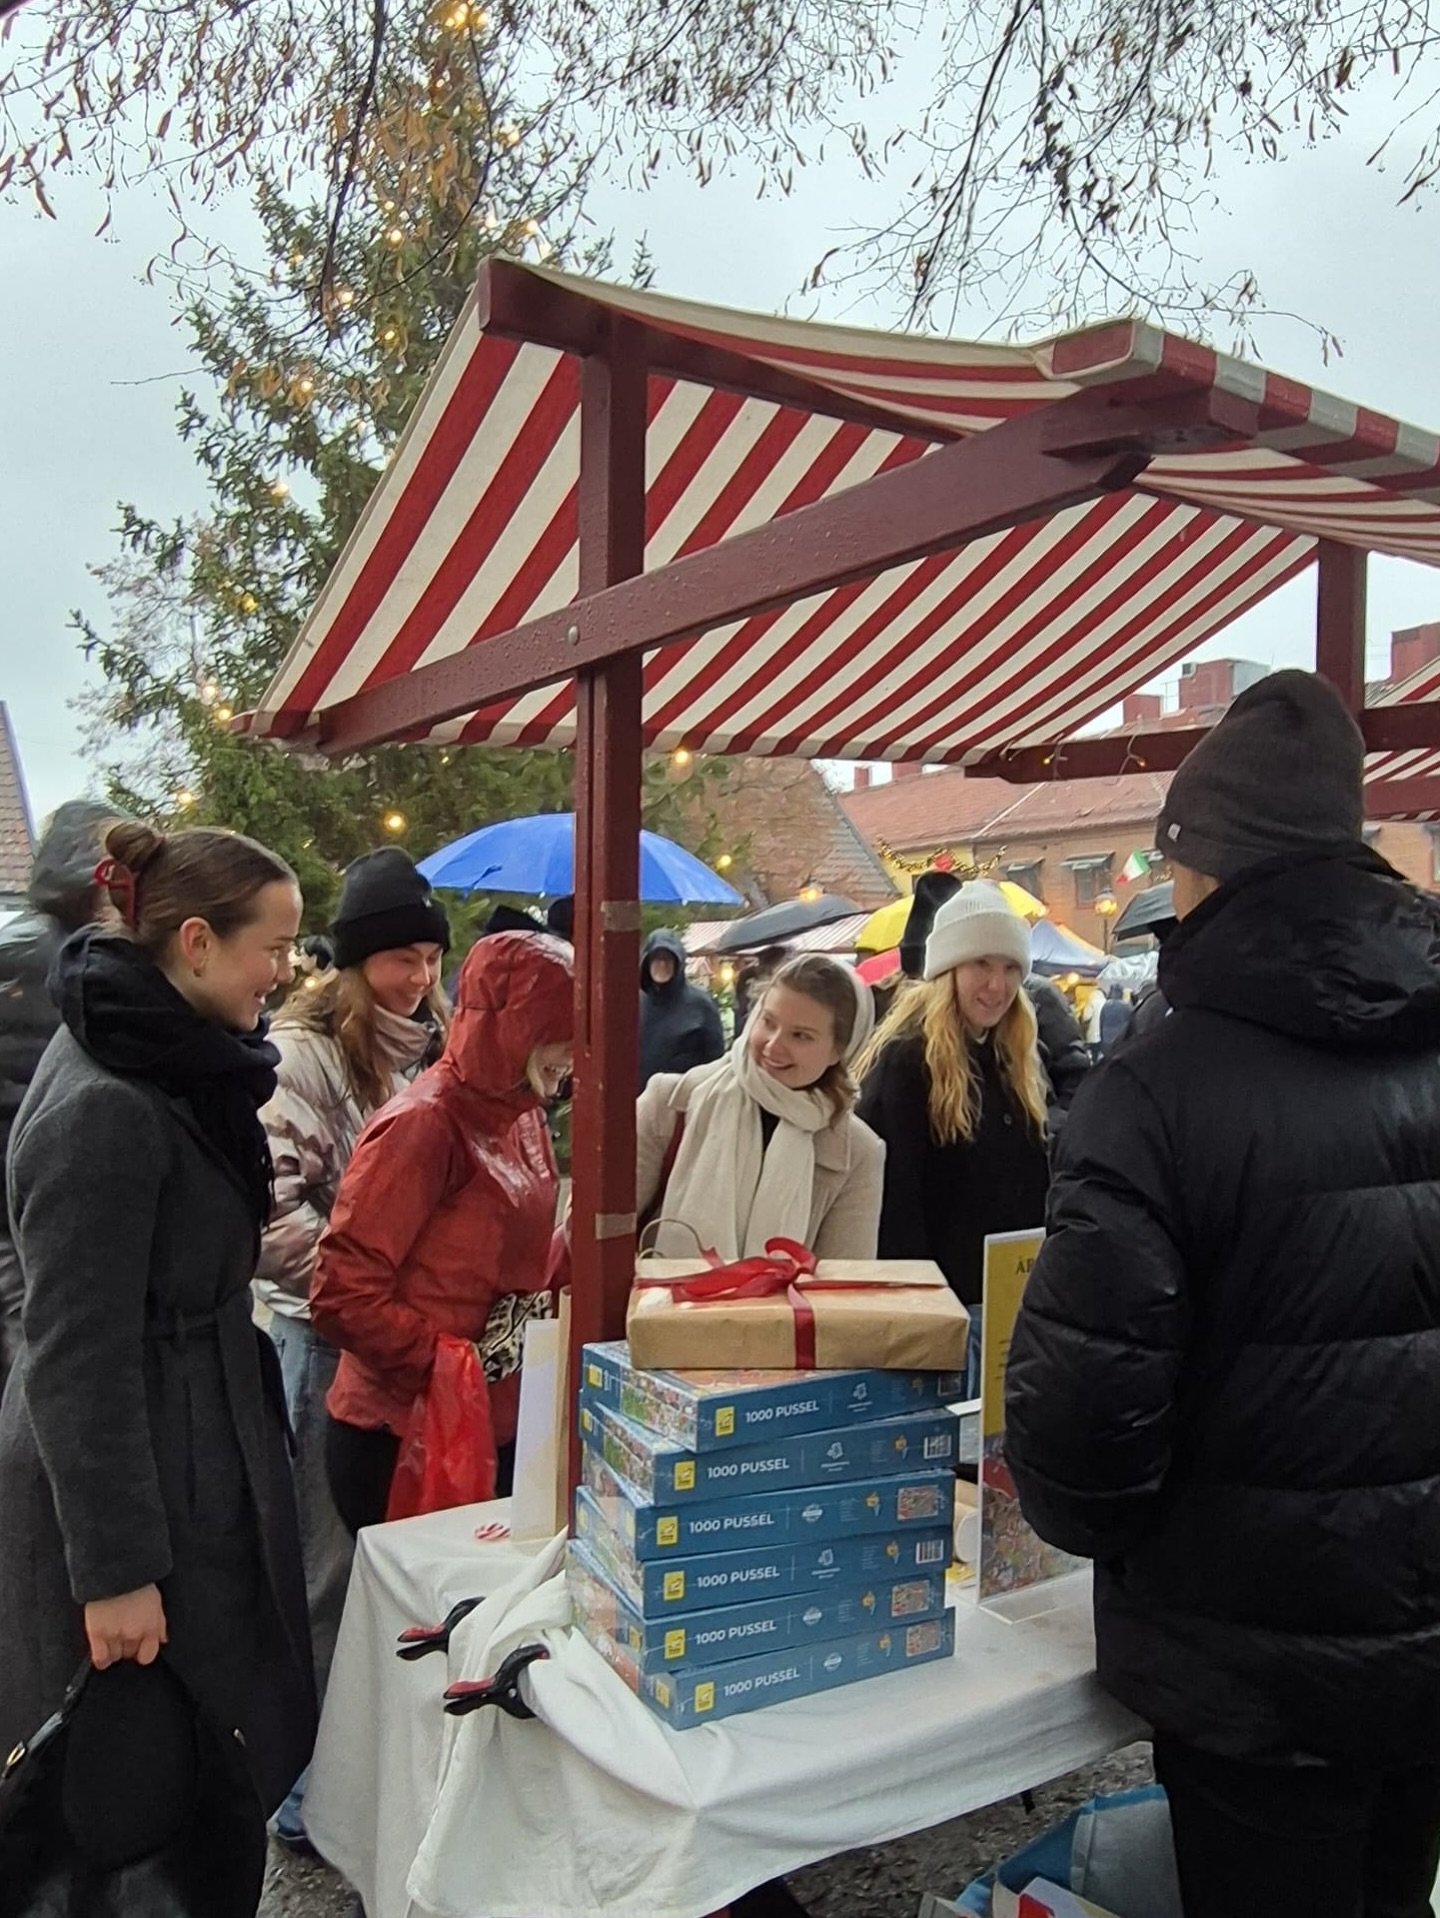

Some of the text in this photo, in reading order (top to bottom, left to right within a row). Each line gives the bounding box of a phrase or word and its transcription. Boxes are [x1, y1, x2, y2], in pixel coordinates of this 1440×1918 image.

[745, 1400, 820, 1423] 1000 PUSSEL
[708, 1458, 790, 1479] 1000 PUSSEL
[689, 1513, 775, 1534] 1000 PUSSEL
[697, 1566, 780, 1588] 1000 PUSSEL
[695, 1620, 777, 1645] 1000 PUSSEL
[724, 1667, 800, 1696] 1000 PUSSEL
